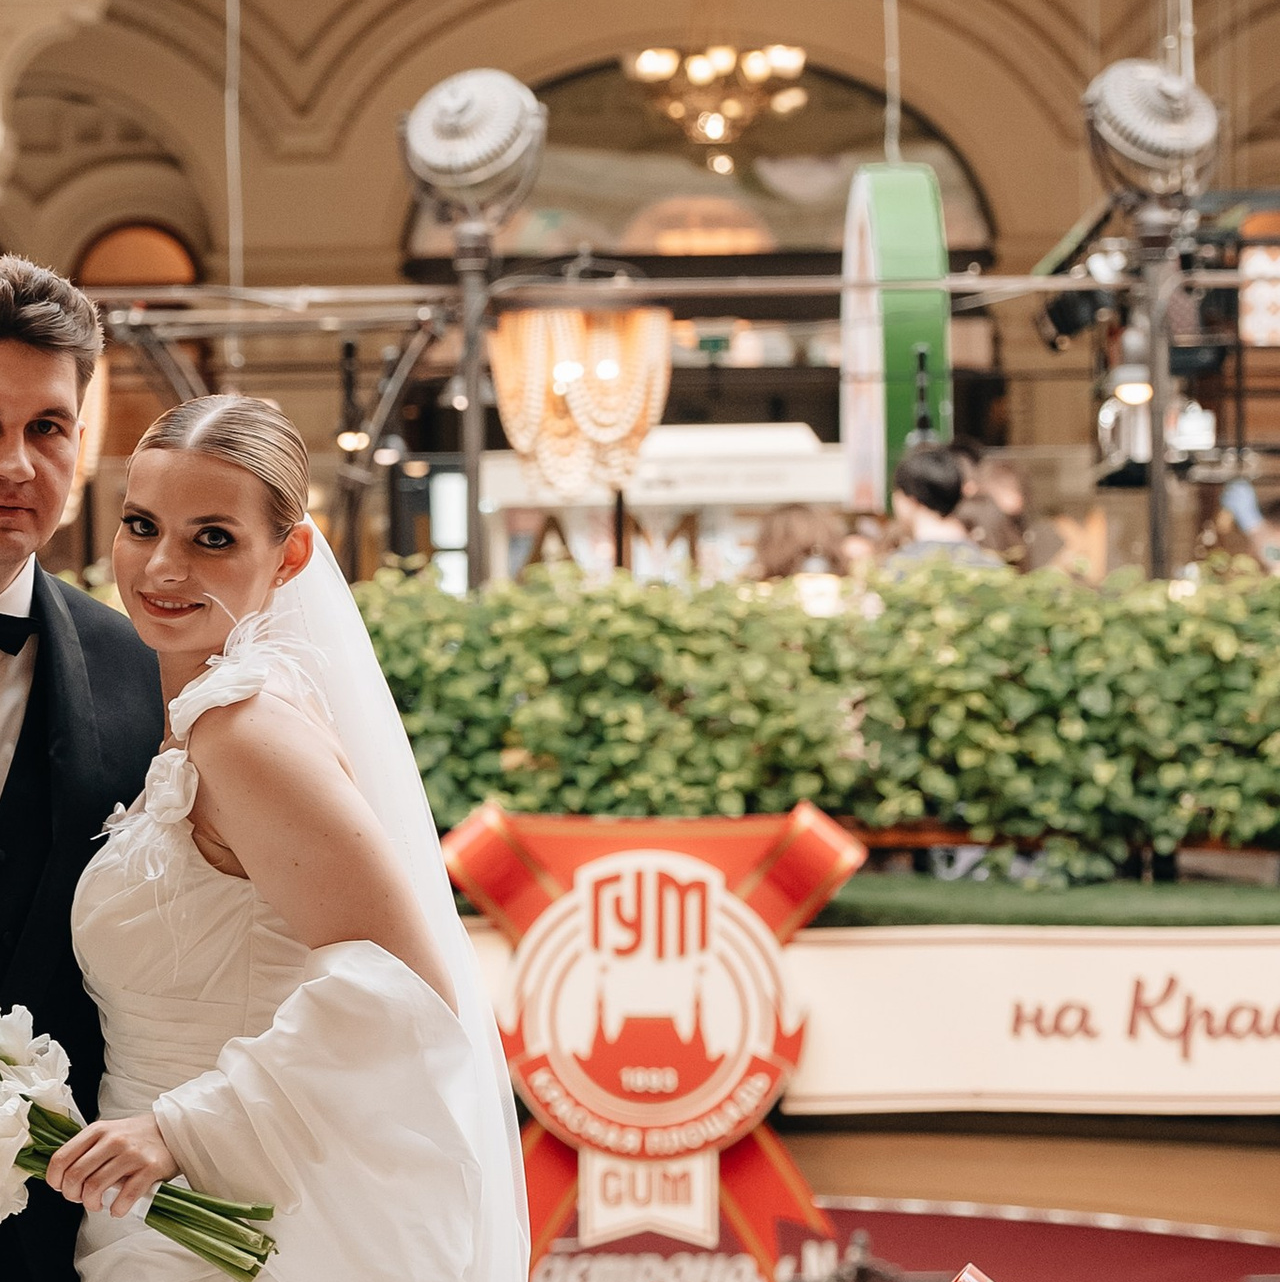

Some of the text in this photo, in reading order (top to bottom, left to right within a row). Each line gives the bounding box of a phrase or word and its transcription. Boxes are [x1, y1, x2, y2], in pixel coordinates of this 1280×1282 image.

[591, 870, 708, 959] ГУМ
[1008, 999, 1098, 1041] на
[600, 1169, 693, 1206] GUM
